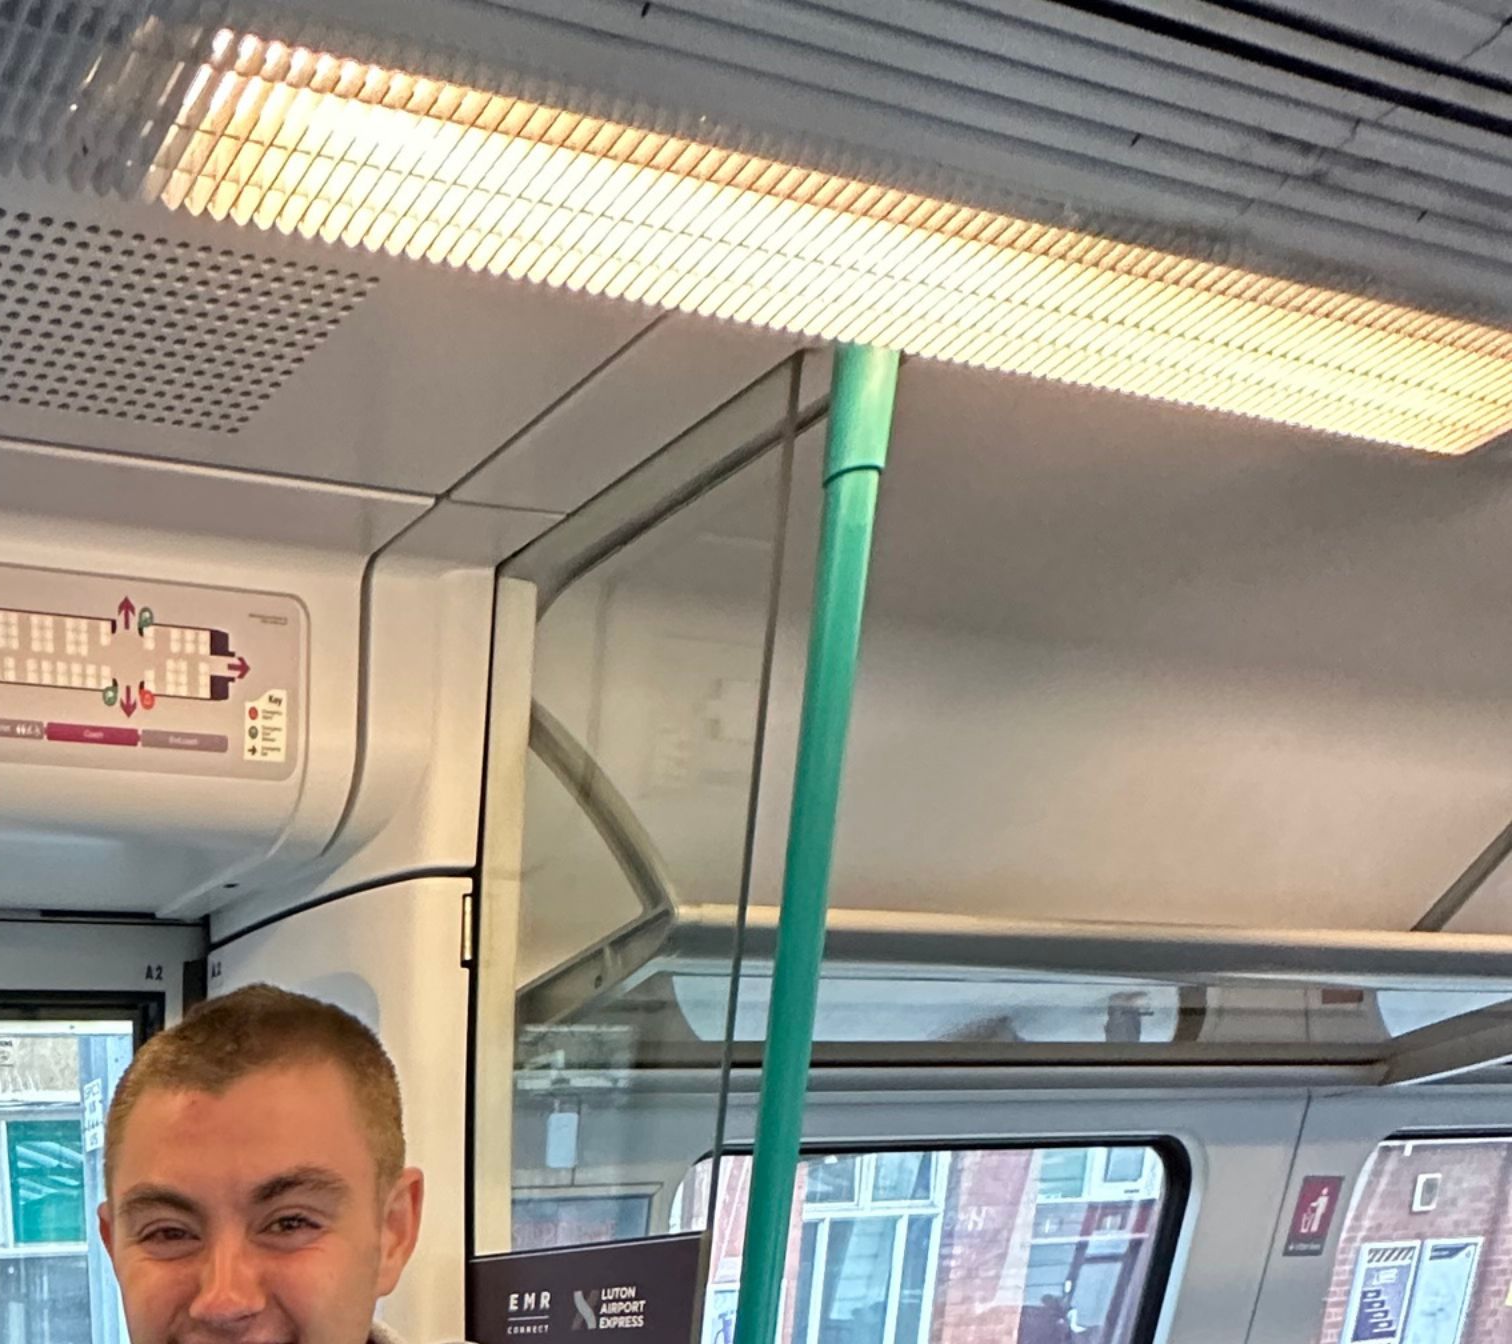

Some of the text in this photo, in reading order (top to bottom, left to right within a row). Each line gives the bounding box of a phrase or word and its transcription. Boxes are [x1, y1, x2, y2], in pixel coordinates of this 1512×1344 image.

[145, 963, 164, 981] A2
[601, 1286, 637, 1301] LUTON
[508, 1291, 551, 1312] EMR
[599, 1300, 646, 1315] AIRPORT
[599, 1315, 645, 1329] EXPRESS
